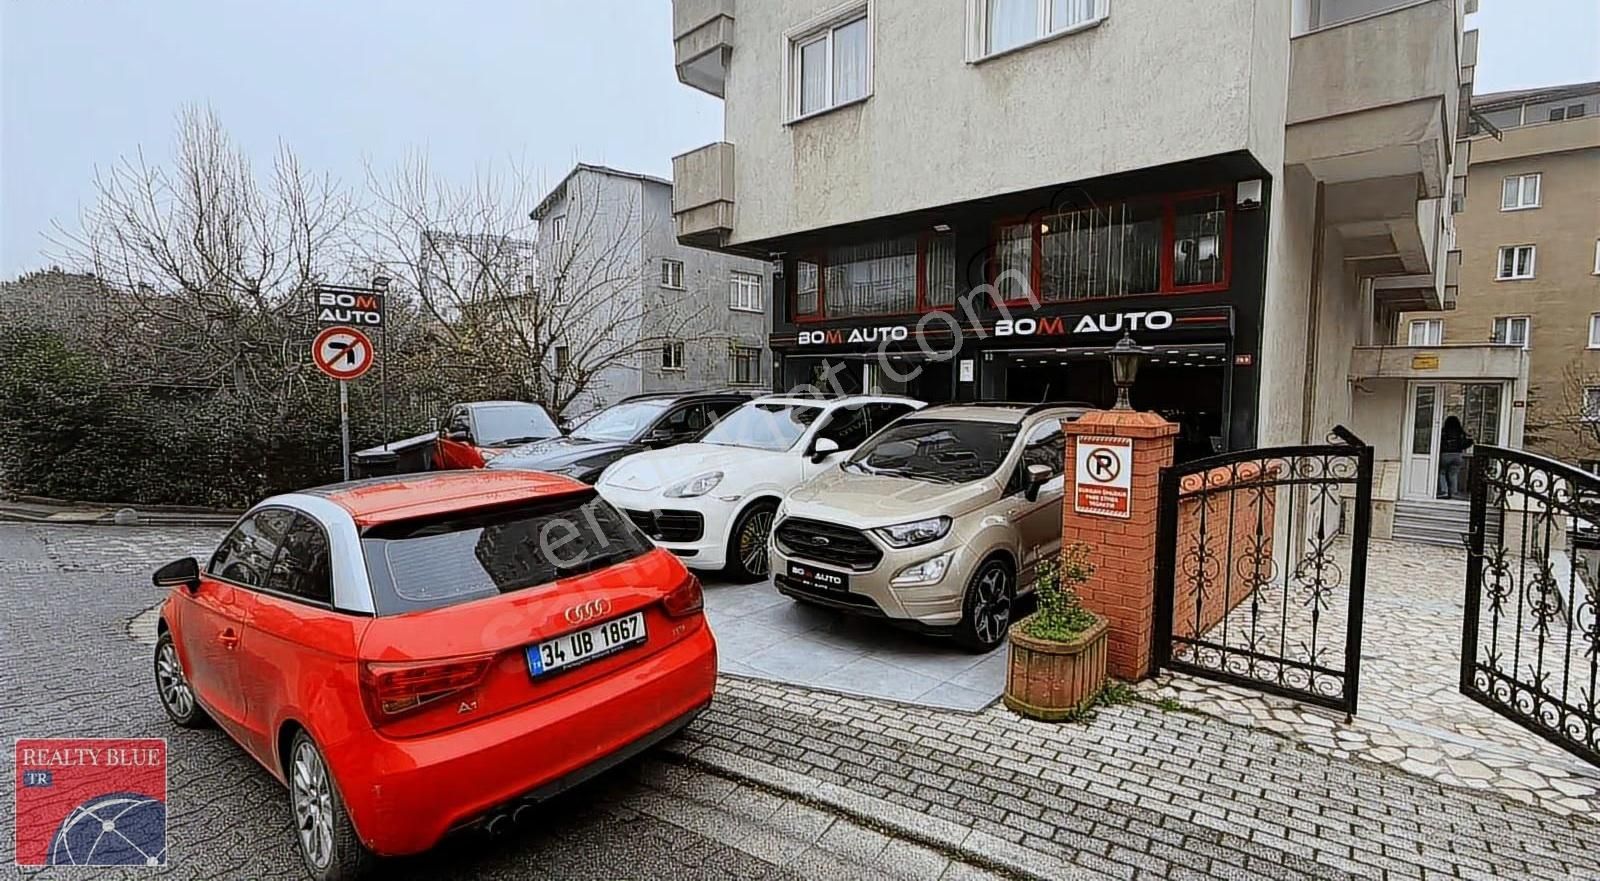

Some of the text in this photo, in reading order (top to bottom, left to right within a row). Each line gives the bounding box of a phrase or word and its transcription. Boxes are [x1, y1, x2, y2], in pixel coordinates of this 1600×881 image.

[319, 292, 377, 309] BOM
[319, 308, 380, 324] AUTO
[995, 310, 1173, 336] BOM AUTO
[798, 325, 908, 345] BOM AUTO
[814, 572, 842, 585] AUTO
[542, 640, 566, 667] 34
[570, 631, 594, 657] UB
[601, 616, 638, 647] 1867
